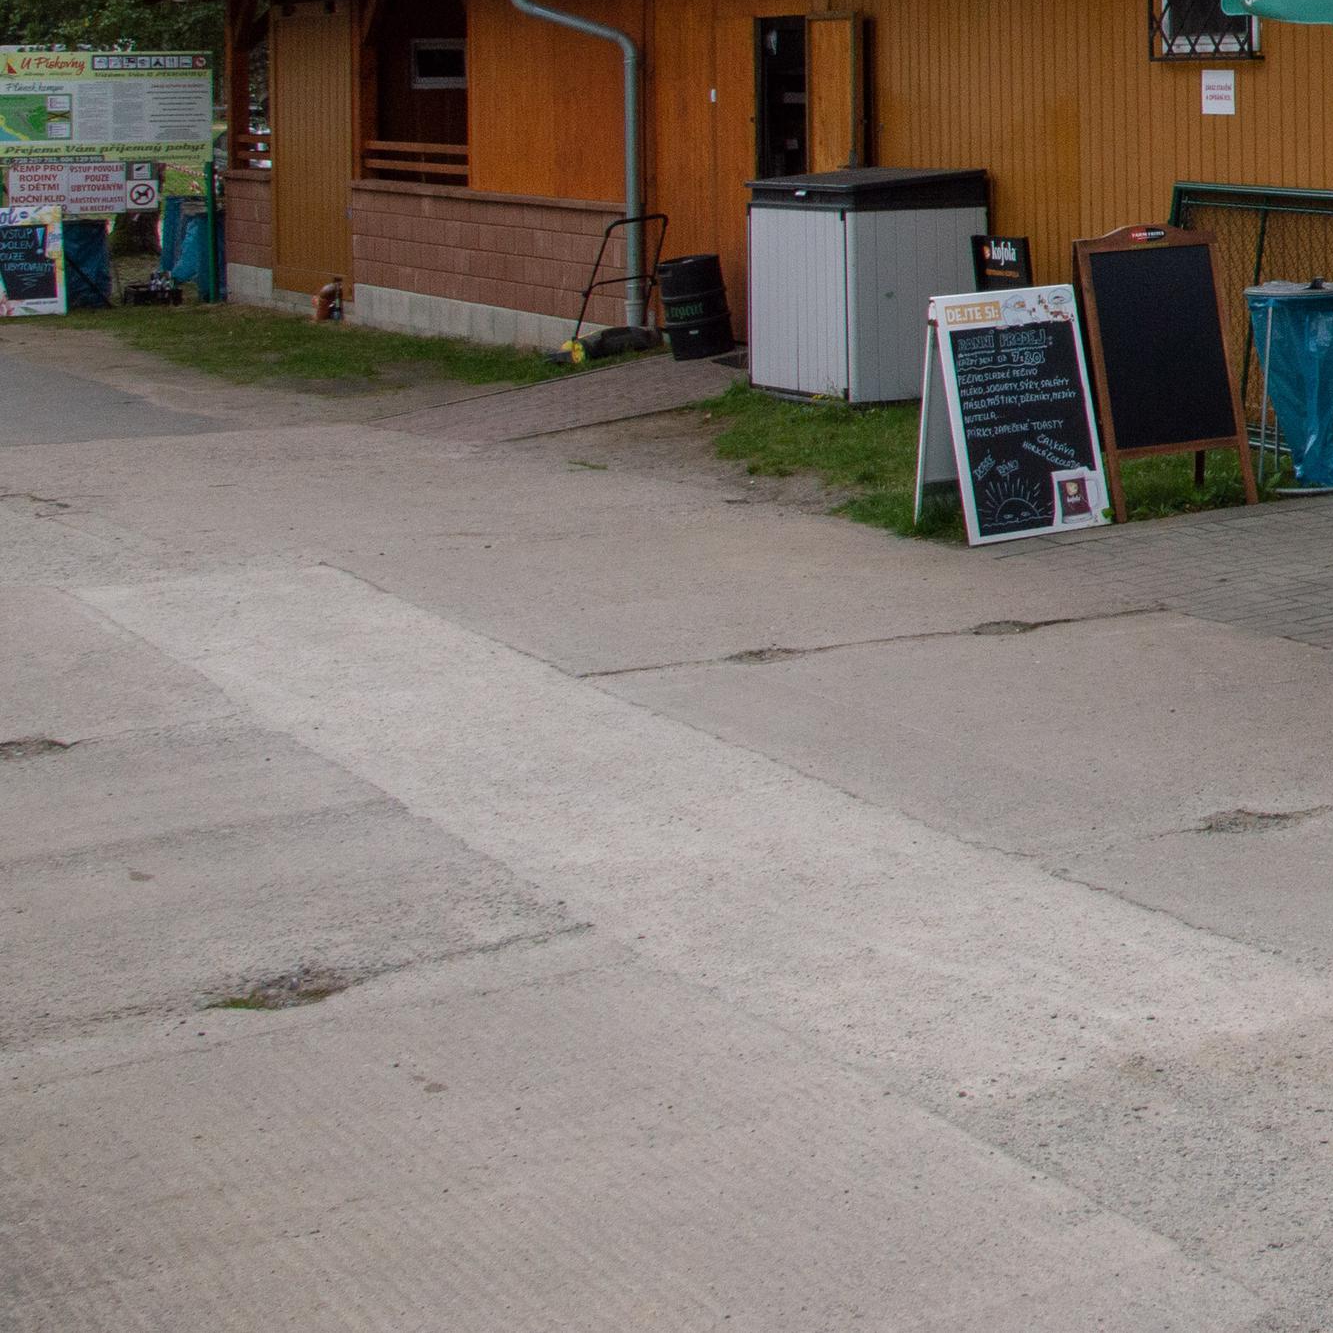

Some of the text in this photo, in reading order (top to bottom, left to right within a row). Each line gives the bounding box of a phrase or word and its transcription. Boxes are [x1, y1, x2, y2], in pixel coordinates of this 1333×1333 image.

[5, 144, 61, 155] Přejeme
[66, 143, 96, 153] Vám
[43, 164, 64, 172] PRO
[19, 174, 58, 182] RODINY
[11, 195, 66, 204] NOČNÍ KLID
[991, 240, 1017, 266] kofola
[946, 305, 999, 323] DEJTE SI:
